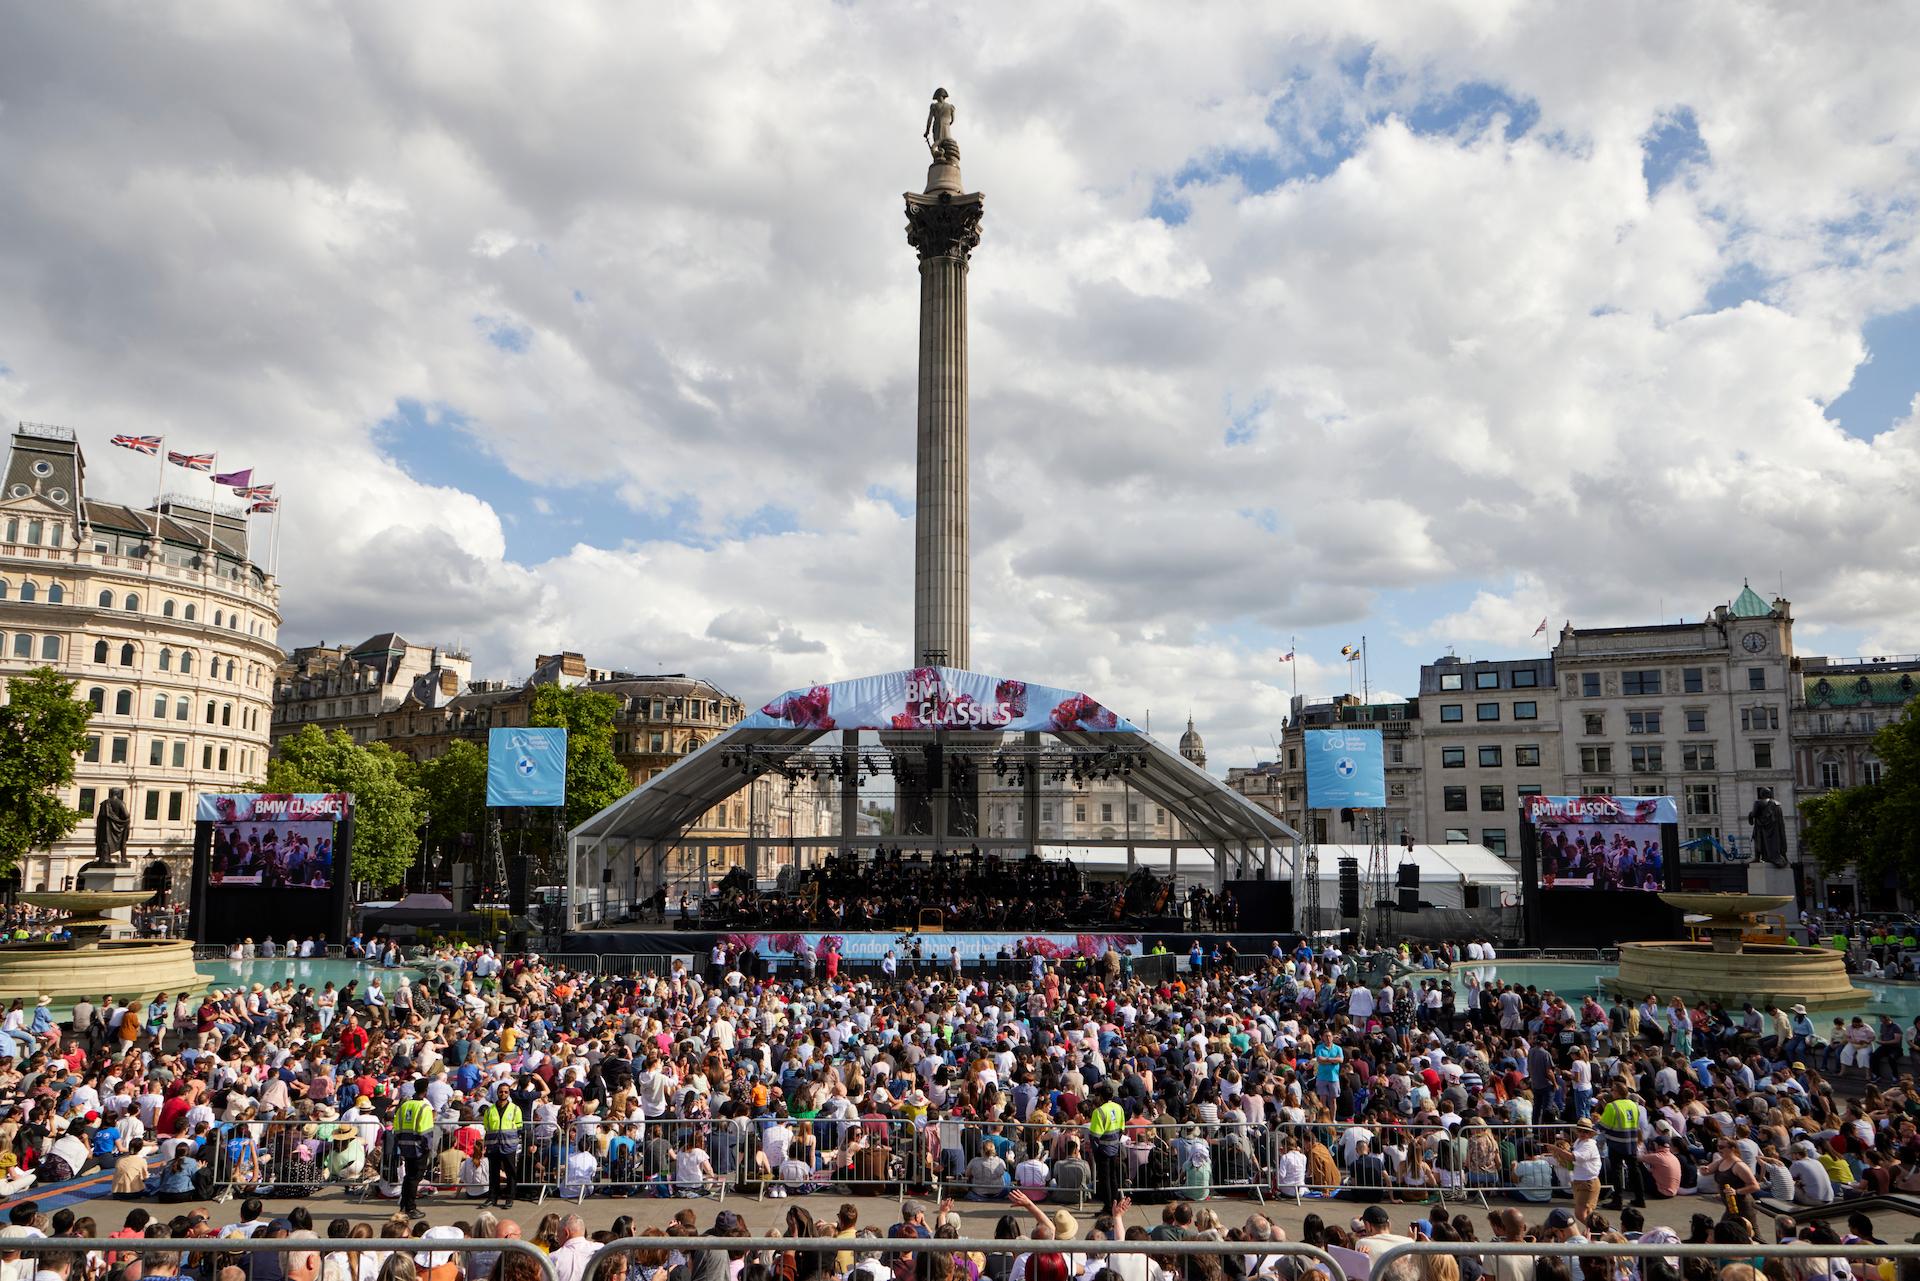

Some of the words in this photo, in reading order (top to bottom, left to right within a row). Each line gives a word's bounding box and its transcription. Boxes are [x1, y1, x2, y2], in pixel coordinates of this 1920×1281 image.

[906, 680, 957, 703] BMW
[919, 702, 1012, 725] CLASSICS
[255, 801, 287, 813] BMW
[289, 801, 343, 814] CLASSICS
[1532, 803, 1563, 817] BMW
[1566, 802, 1618, 816] CLASSICS
[845, 938, 889, 954] London
[958, 940, 1013, 955] Orchesta
